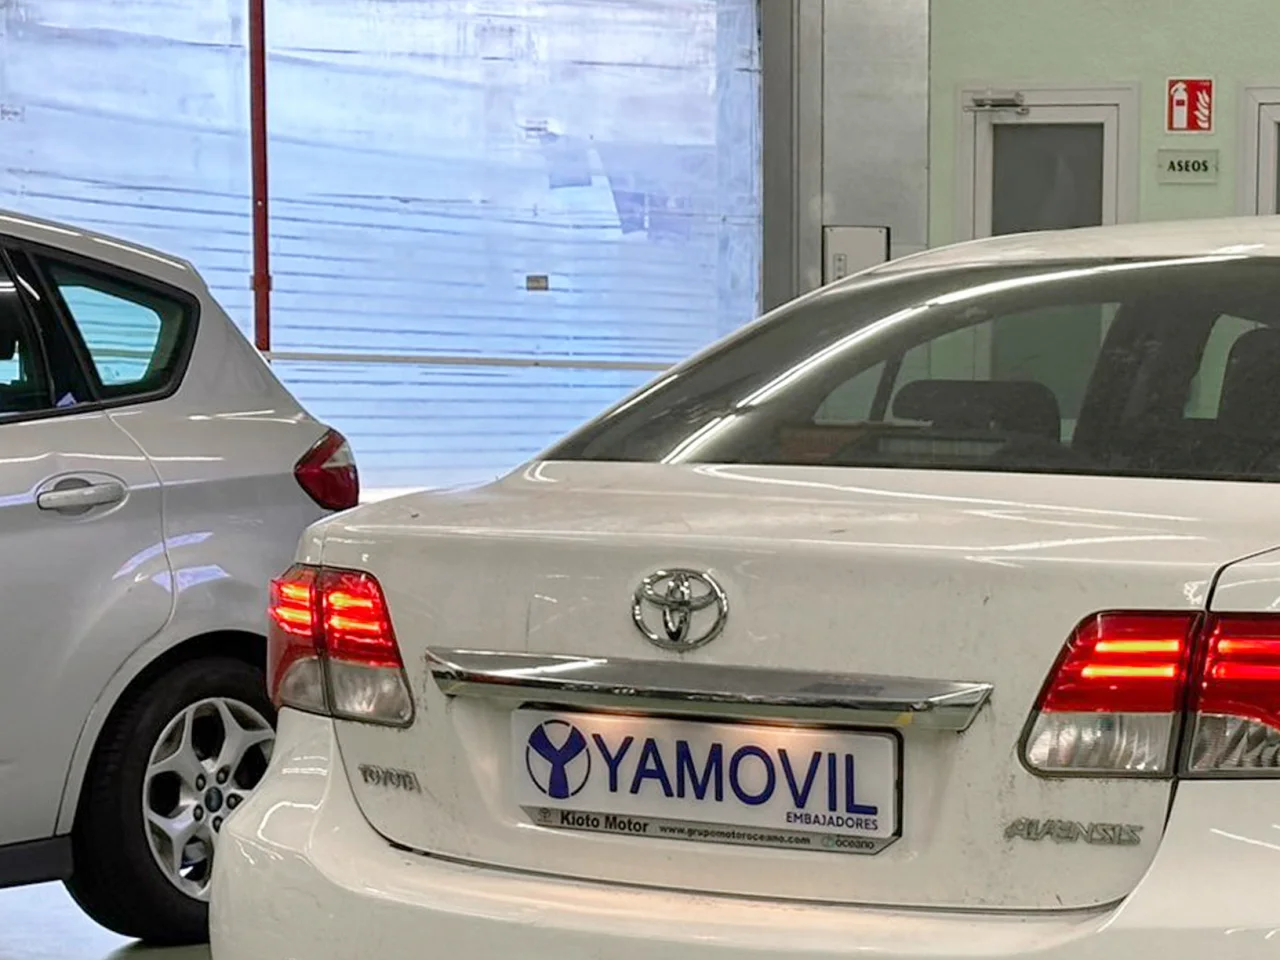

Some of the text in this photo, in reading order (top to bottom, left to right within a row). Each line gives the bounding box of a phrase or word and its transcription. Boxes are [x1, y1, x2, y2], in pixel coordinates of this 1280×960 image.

[1167, 160, 1209, 172] ASEOS
[592, 733, 878, 815] YAMOVIL
[560, 809, 600, 829] Kioto
[604, 814, 649, 833] Motor
[786, 811, 879, 831] EMBAJADORES
[1003, 818, 1144, 846] AVENSIS
